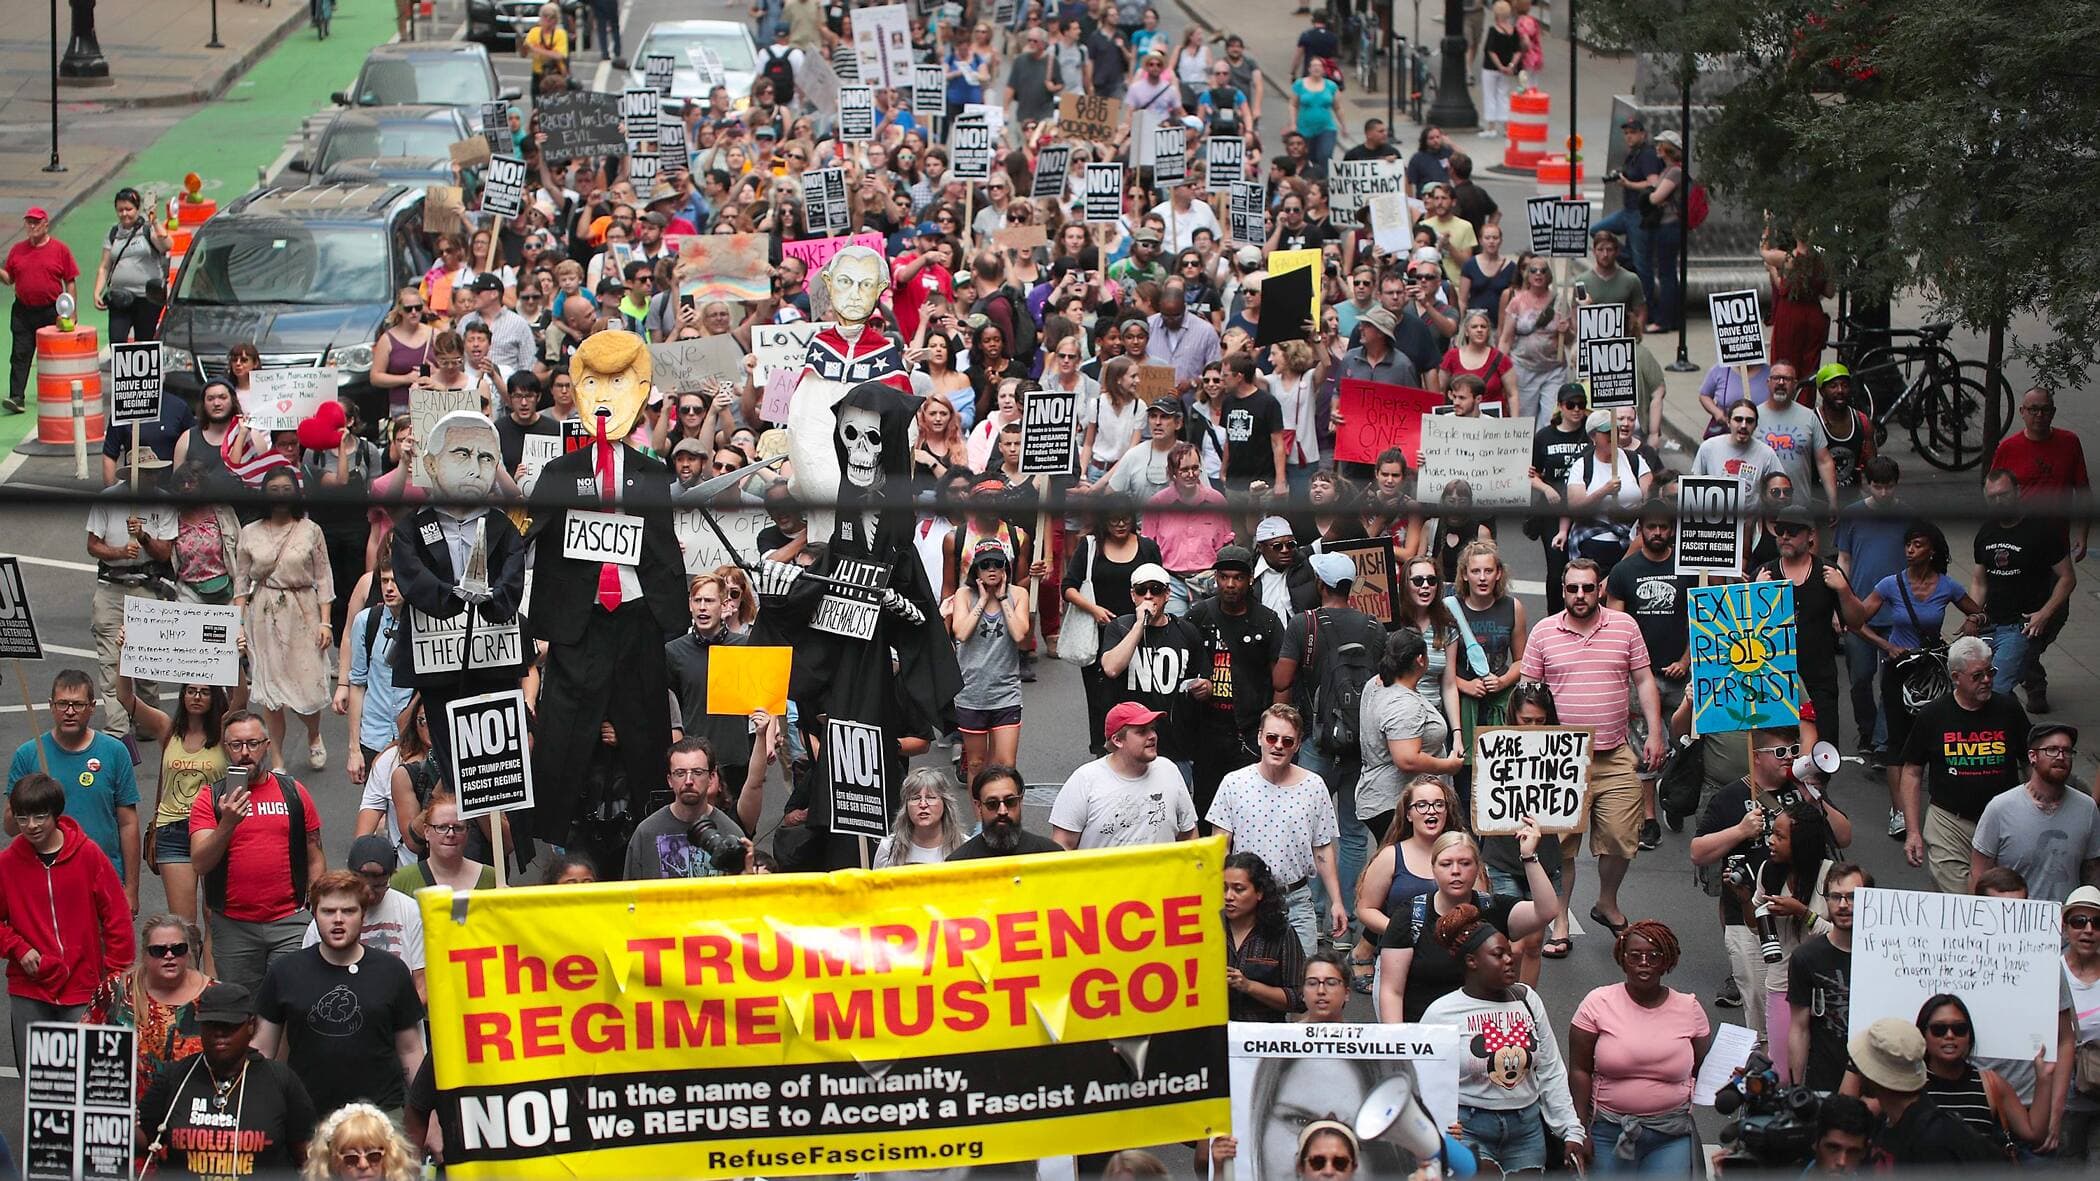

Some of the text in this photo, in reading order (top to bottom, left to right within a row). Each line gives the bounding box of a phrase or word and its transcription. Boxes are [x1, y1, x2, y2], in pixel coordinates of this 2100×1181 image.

[645, 58, 673, 76] NO!
[916, 70, 943, 89] NO!
[626, 93, 657, 115] NO!
[1076, 95, 1107, 108] ARE
[1077, 108, 1107, 122] YOU
[562, 129, 598, 144] EVIL
[660, 127, 684, 146] NO!
[956, 128, 988, 150] NO!
[1059, 121, 1111, 140] KIDDING
[1156, 130, 1184, 156] NO!
[1211, 143, 1240, 165] NO!
[490, 159, 524, 186] NO!
[1039, 152, 1065, 173] NO!
[1334, 163, 1378, 177] WHITE
[804, 173, 822, 189] NO!
[1088, 169, 1119, 194] NO!
[1329, 174, 1402, 194] SUPREMACY
[1354, 196, 1363, 208] IS
[1555, 205, 1588, 229] NO!
[1714, 297, 1755, 326] NO!
[1581, 307, 1621, 339] NO!
[1718, 324, 1758, 337] DRIVE OUT
[116, 350, 158, 378] NO!
[1591, 342, 1632, 374] NO!
[115, 379, 159, 391] DRIVE OUT
[115, 390, 159, 400] TRUMP/PENCE
[1598, 388, 1614, 397] FASCIST
[1615, 386, 1633, 396] AMERICA
[123, 399, 150, 409] REGIME!
[410, 390, 475, 411] GRANDPA
[1028, 398, 1073, 425] ¡NO!
[1359, 423, 1409, 447] ONE
[1513, 428, 1530, 439] hate
[577, 478, 594, 488] NO!
[1682, 485, 1736, 524] NO!
[420, 521, 439, 535] NO!
[566, 518, 642, 557] FASCIST
[1682, 530, 1735, 540] STOP TRUMP/PENCE
[1682, 541, 1734, 551] FASCIST REGIME
[1695, 583, 1792, 623] EXIST
[810, 600, 879, 638] SUPREMACIST
[3, 628, 32, 637] DETENIDO
[160, 630, 186, 640] WHY?
[1695, 623, 1797, 667] RESIST
[1128, 645, 1190, 695] NO!
[1698, 670, 1797, 707] PERSIST
[456, 707, 519, 760] NO!
[1943, 730, 2005, 743] BLACK
[832, 724, 881, 788] NO!
[1479, 732, 1589, 759] WE'RE JUST
[1944, 741, 2006, 756] LIVES
[168, 759, 213, 771] LOVE IS
[461, 758, 521, 777] STOP TRUMP/PENCE
[1490, 756, 1578, 786] GETTING
[1945, 755, 2006, 766] MATTER
[462, 772, 523, 793] FASCIST REGIME
[463, 789, 524, 806] RefuseFascism.org
[837, 799, 883, 816] DEBE SER DETENIDO
[1488, 783, 1578, 822] STARTED
[1861, 890, 2064, 937] BLACK LIVES MATTER
[448, 894, 1204, 999] The TRUMP/PENCE
[1881, 935, 2012, 959] you are neutral in
[1892, 951, 1908, 964] of
[1976, 955, 1999, 972] you
[2004, 956, 2030, 973] have
[1895, 964, 2021, 987] chosen the side of the
[463, 958, 1199, 1065] REGIME MUST GO!
[1467, 1011, 1503, 1033] MINNIE
[1305, 1026, 1364, 1040] 8/12/17
[31, 1031, 76, 1068] NO!
[1243, 1040, 1434, 1055] CHARLOTTESVILLE VA
[588, 1065, 969, 1110] In the name of humanity,
[191, 1097, 207, 1112] BA
[587, 1066, 1209, 1141] We REFUSE to Accept a Fascist America!
[459, 1087, 570, 1150] NO!
[85, 1115, 130, 1145] ¡NO!
[186, 1150, 255, 1175] NOTHING
[708, 1139, 984, 1169] RefuseFascism.org
